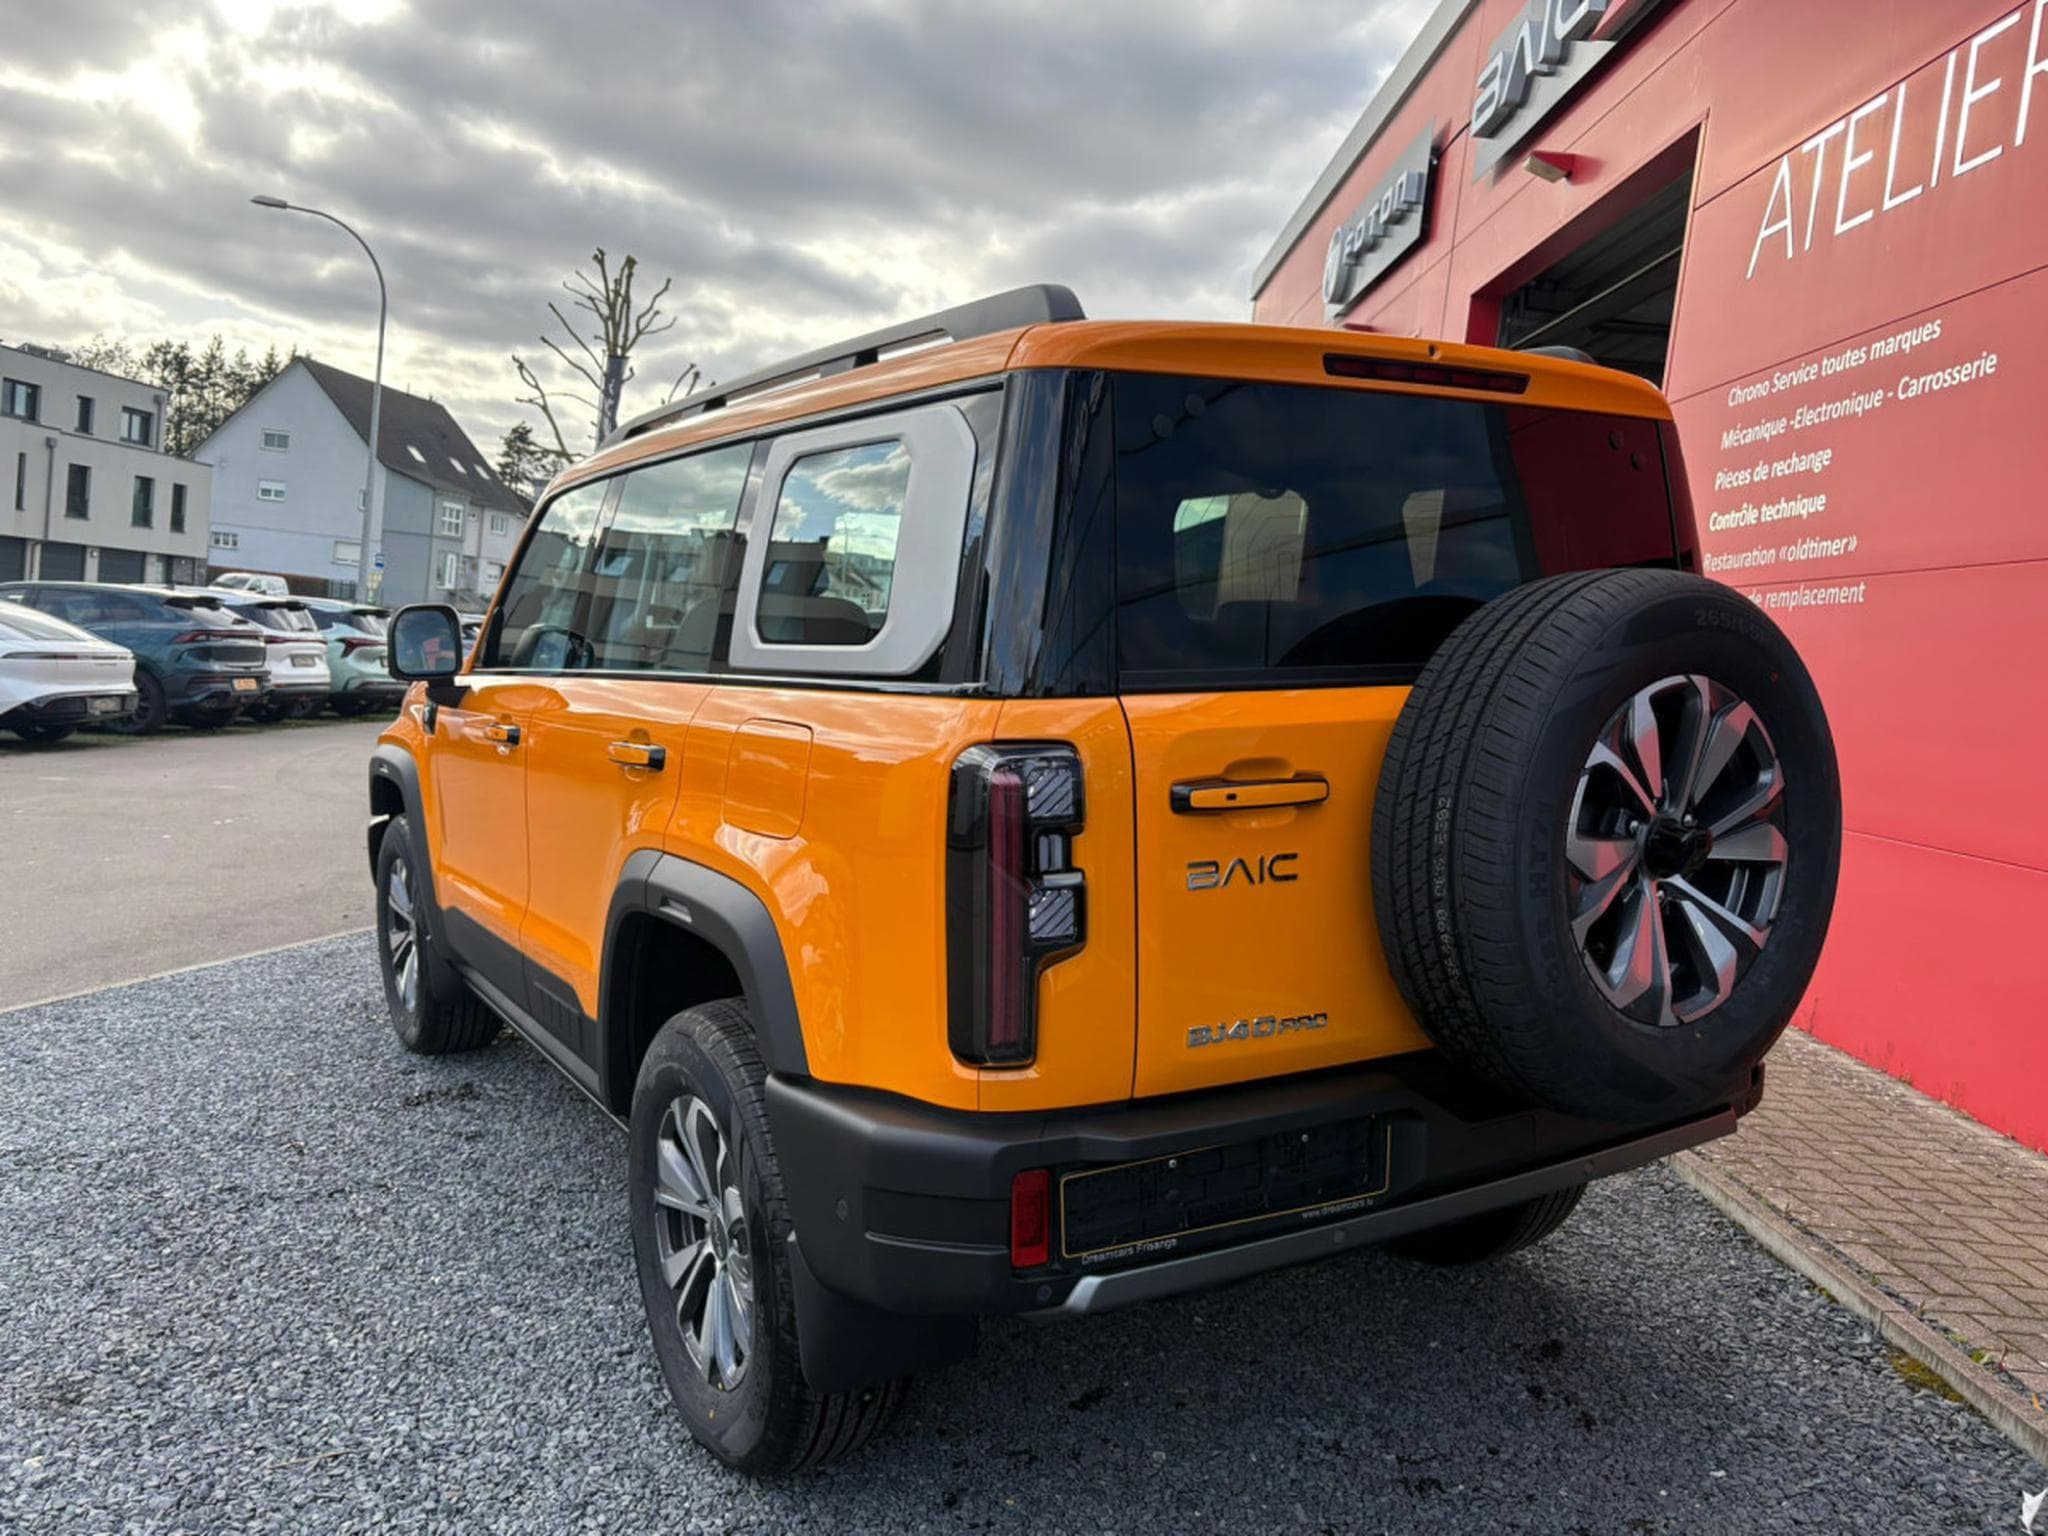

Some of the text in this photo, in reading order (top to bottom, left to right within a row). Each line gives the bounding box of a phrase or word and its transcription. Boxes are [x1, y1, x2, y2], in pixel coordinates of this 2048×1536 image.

[1727, 319, 1942, 407] Chrono Service toutes marques
[1720, 418, 1787, 451] Mécanique
[1897, 351, 1998, 400] Carrosserie
[1753, 460, 1769, 482] de
[1771, 448, 1832, 477] rechange
[1709, 493, 1827, 532] Contrôle technique
[1703, 535, 1858, 572] Restauration «oldtimer»
[1765, 581, 1867, 612] remplacement
[1186, 852, 1299, 890] BAIC
[1187, 1012, 1328, 1048] BJ40 PRO
